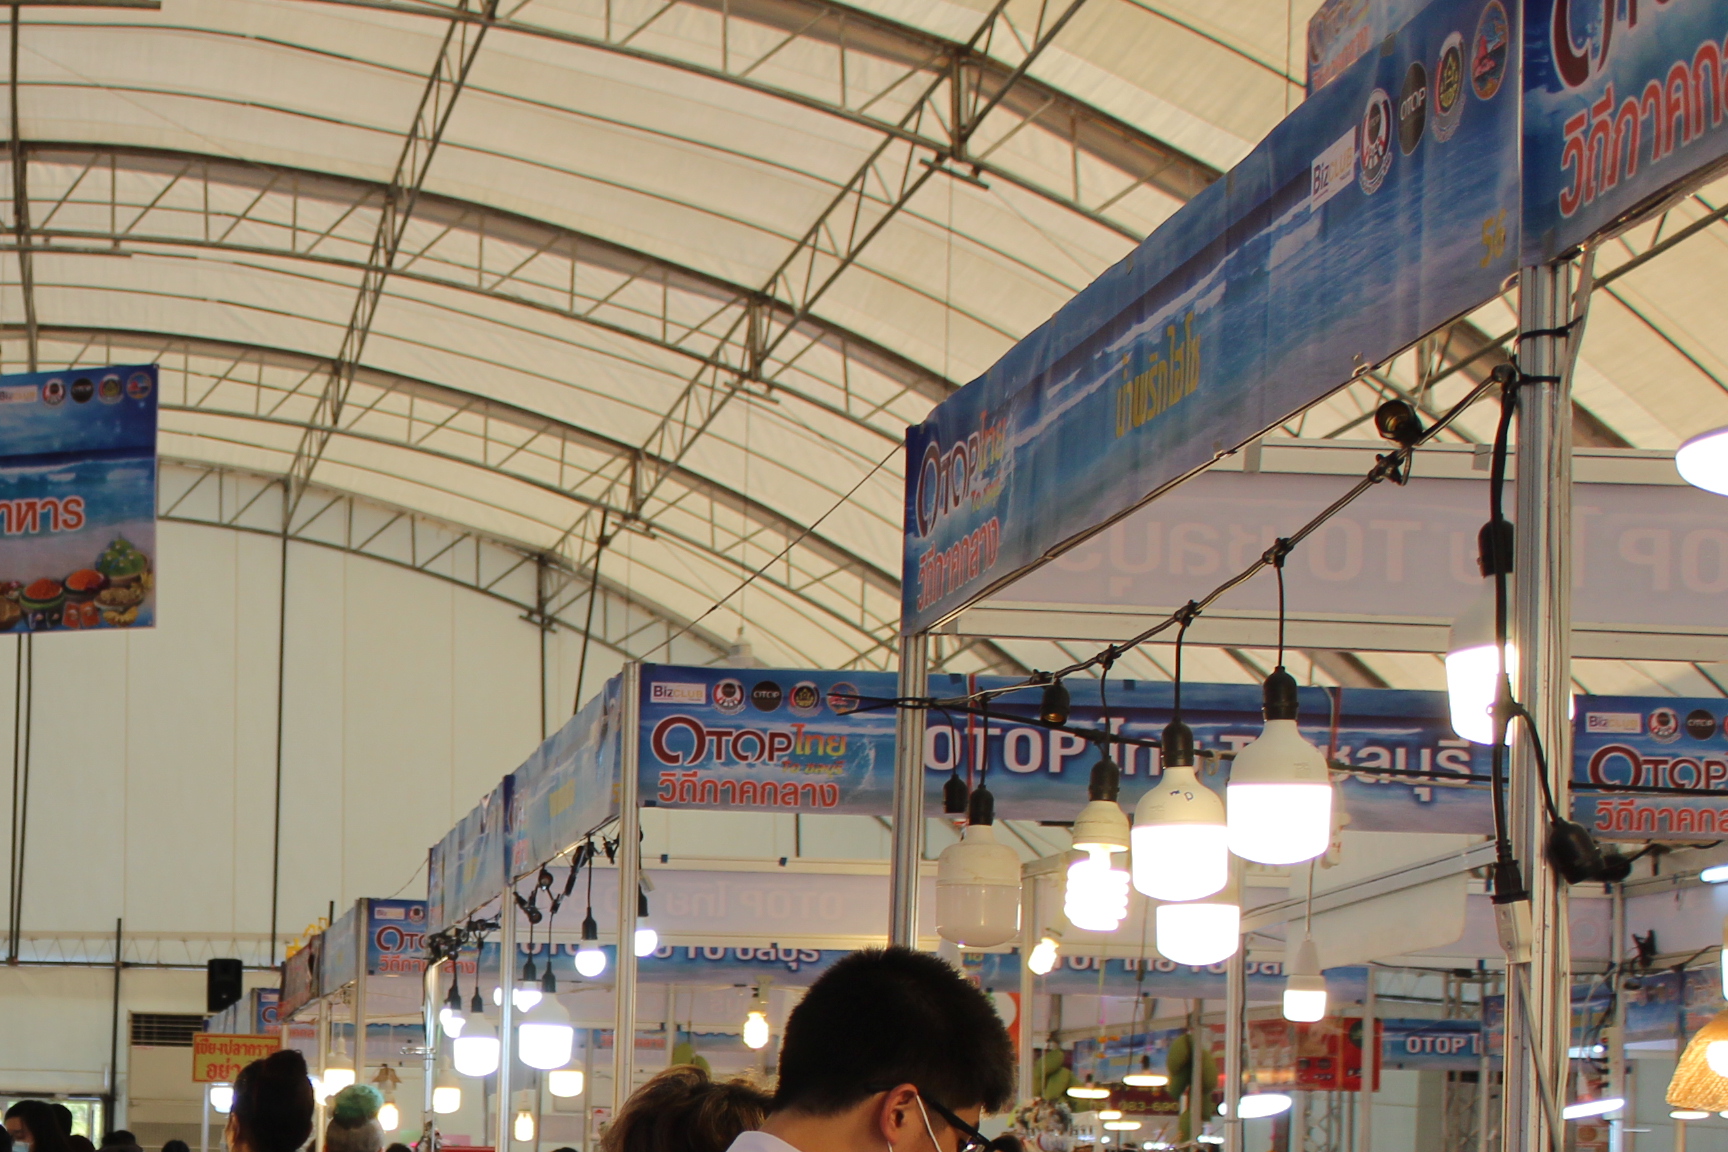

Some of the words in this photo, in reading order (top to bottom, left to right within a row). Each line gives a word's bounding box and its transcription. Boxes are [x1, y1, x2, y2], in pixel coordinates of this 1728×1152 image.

[1480, 207, 1508, 269] 56
[653, 685, 704, 699] BizCLUB
[651, 714, 794, 766] OTOP
[790, 723, 848, 758] ไทย
[658, 770, 840, 808] วิถีภาคกลาง
[1594, 799, 1728, 834] วิถีภาคกล
[1406, 1035, 1467, 1054] OTOP
